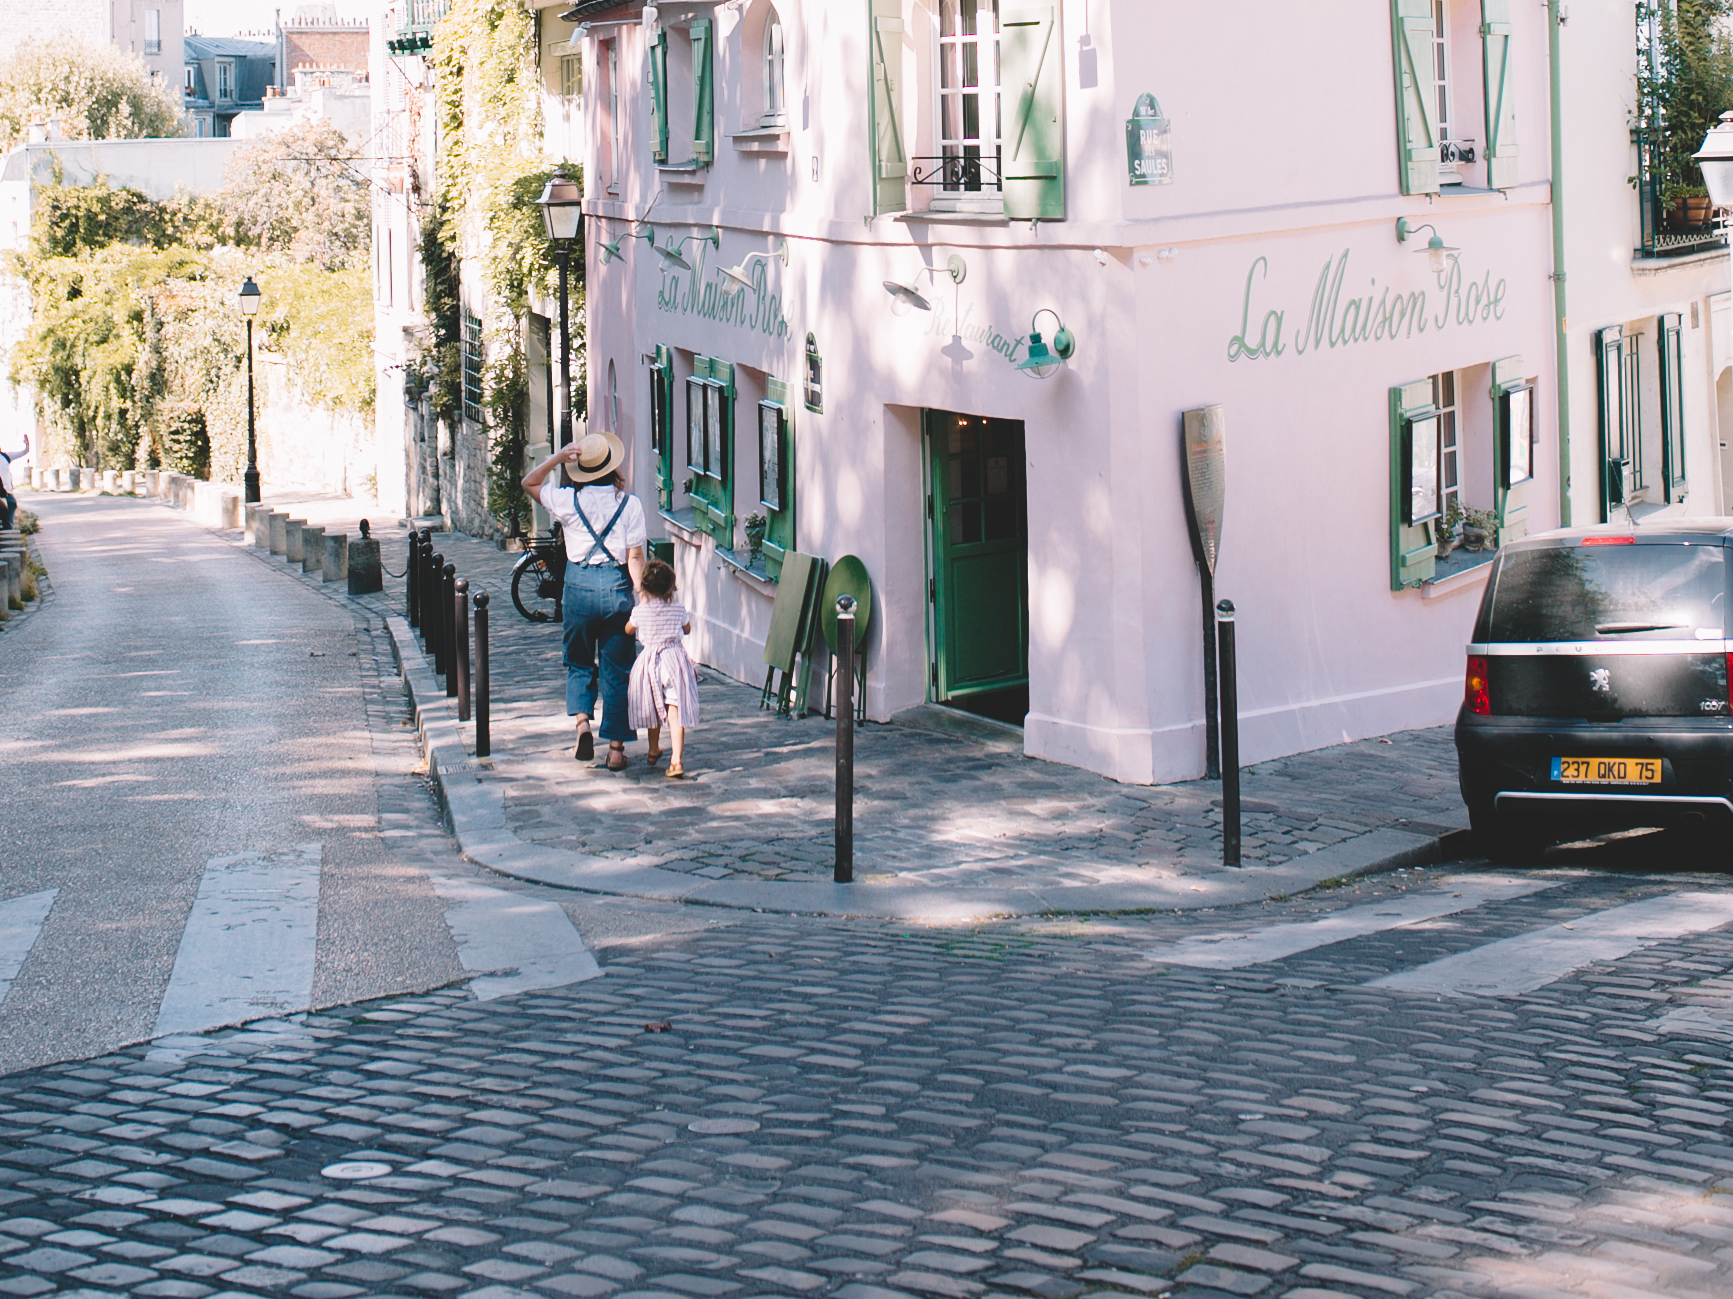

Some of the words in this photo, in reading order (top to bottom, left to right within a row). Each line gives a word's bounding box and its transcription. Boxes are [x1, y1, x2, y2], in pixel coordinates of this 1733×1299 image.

[1139, 129, 1159, 145] RUE
[1145, 148, 1155, 156] DES
[1134, 159, 1168, 175] SAULES
[1227, 256, 1286, 362] La
[1295, 248, 1428, 355] Maison
[1435, 252, 1506, 332] Rose
[1561, 761, 1590, 779] 237
[1598, 762, 1627, 779] QKD
[1635, 762, 1655, 780] 75
